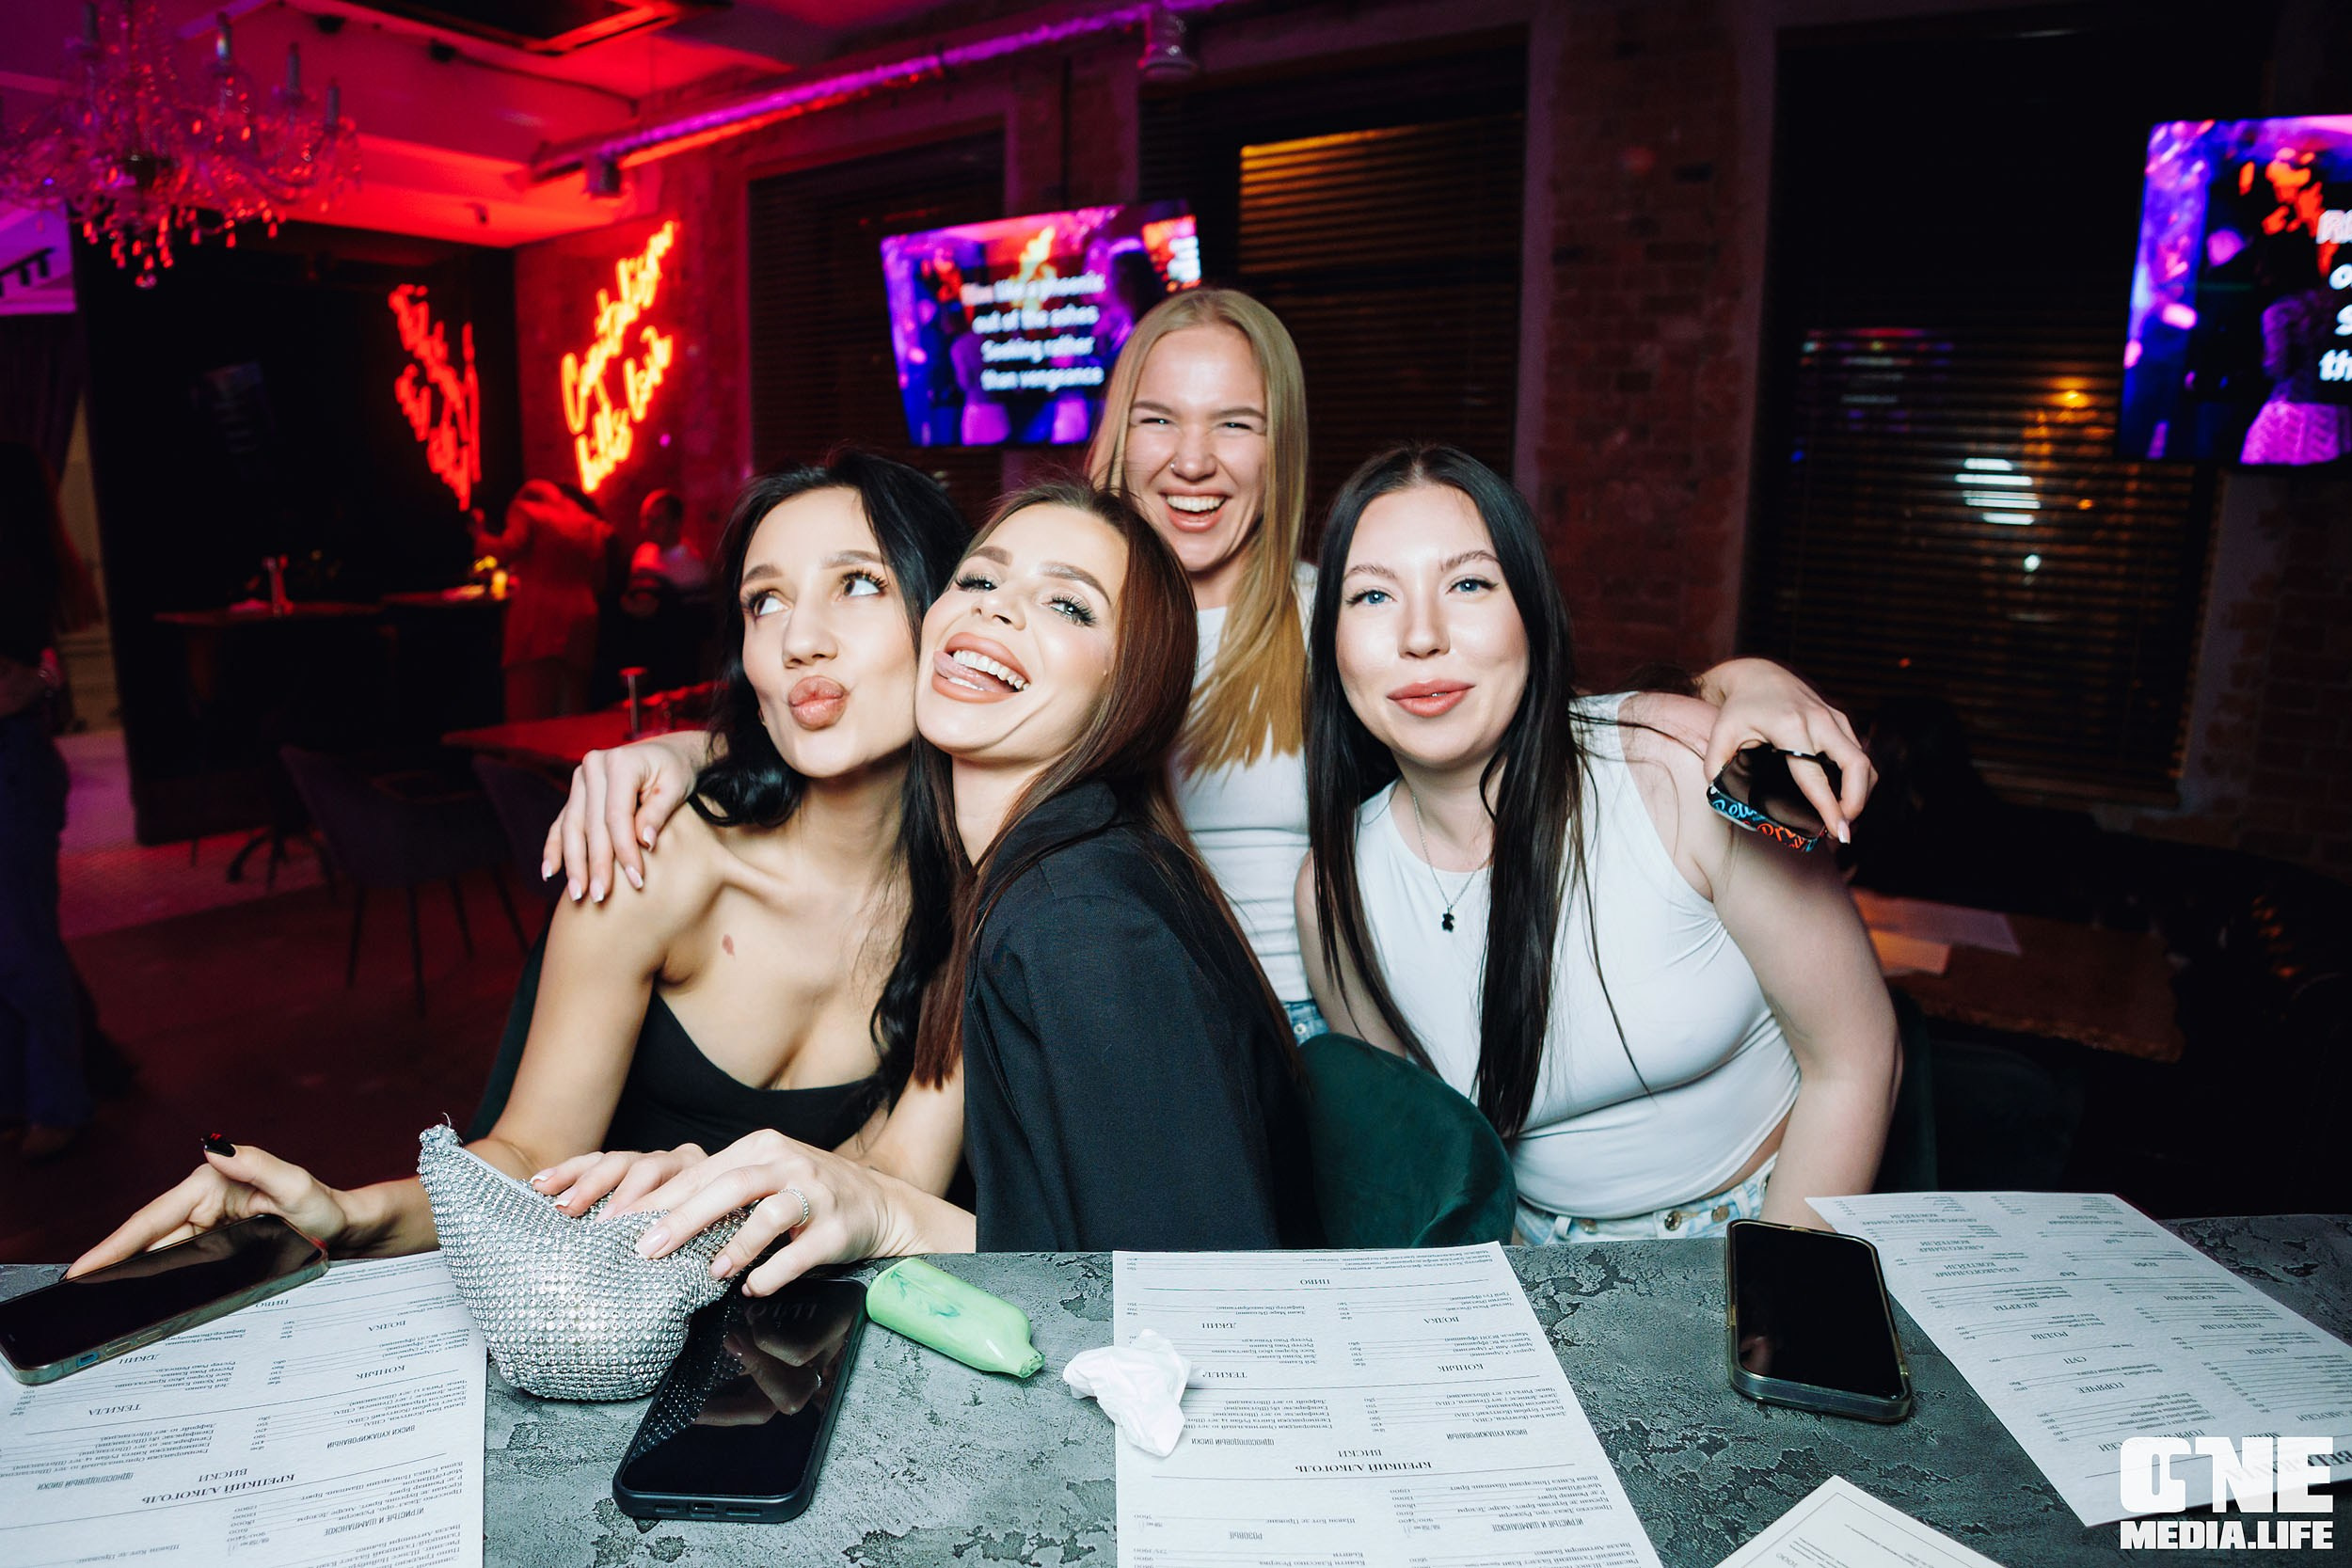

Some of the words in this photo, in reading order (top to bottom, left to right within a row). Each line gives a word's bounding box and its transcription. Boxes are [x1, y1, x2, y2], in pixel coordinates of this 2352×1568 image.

[1994, 1303, 2041, 1311] ДЕСЕРТЫ
[369, 1321, 406, 1332] ВОДКА
[1423, 1317, 1460, 1325] ВОДКА
[2030, 1332, 2070, 1340] РОЛЛЫ
[2062, 1356, 2089, 1365] СУП
[357, 1365, 405, 1381] КОНЬЯК
[1438, 1364, 1485, 1372] КОНЬЯК
[2075, 1382, 2125, 1394] ГОРЯЧЕЕ
[88, 1402, 141, 1418] ТЕКИЛА
[392, 1425, 415, 1435] ВИСКИ
[1337, 1449, 1382, 1458] ВИСКИ
[1295, 1464, 1365, 1474] АЛКОГОЛЬ
[1369, 1461, 1431, 1474] КРЕПКИЙ
[199, 1468, 247, 1483] ВИСКИ
[38, 1481, 63, 1492] ВИСКИ
[225, 1474, 294, 1492] КРЕПКИЙ
[142, 1485, 221, 1506] АЛКОГОЛЬ
[388, 1507, 424, 1523] ИГРИСТЫЕ
[325, 1518, 377, 1537] ШАМПАНСКОЕ
[1492, 1522, 1541, 1532] ШАМПАНСКОЕ
[1548, 1518, 1584, 1528] ИГРИСТЫЕ
